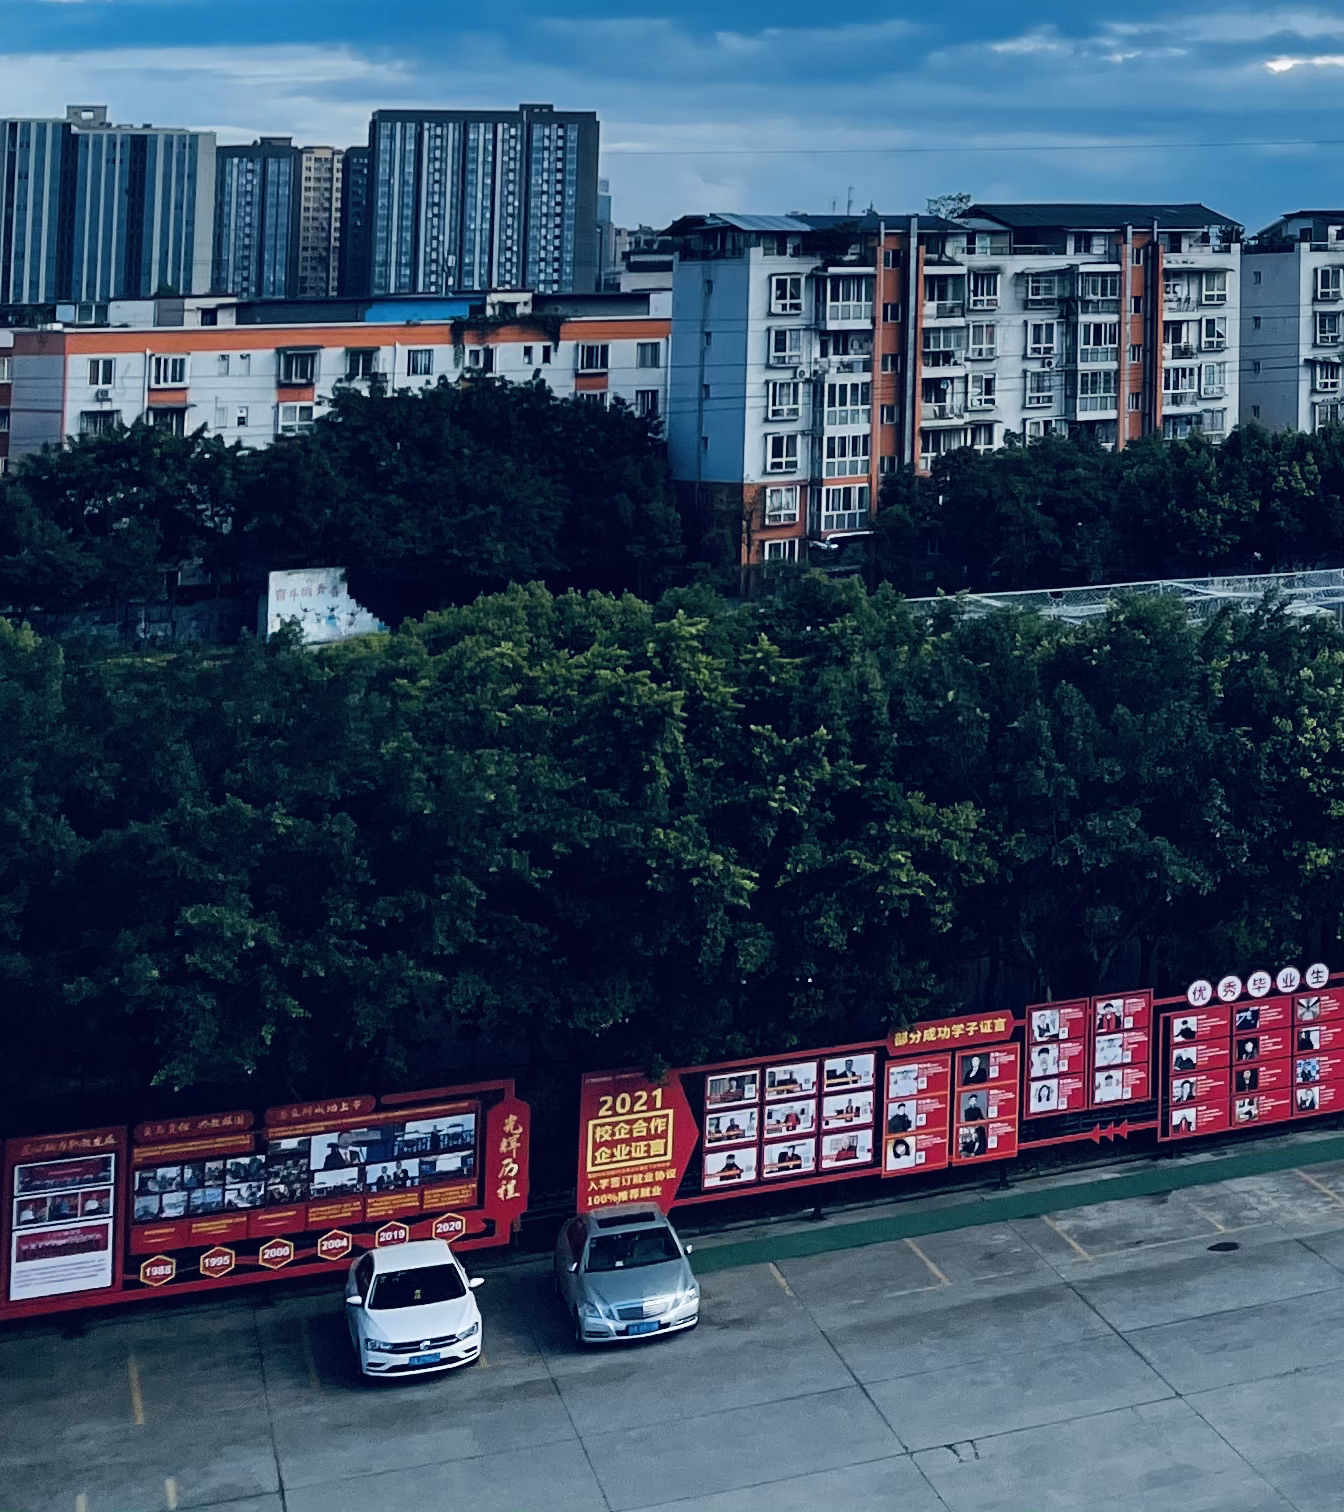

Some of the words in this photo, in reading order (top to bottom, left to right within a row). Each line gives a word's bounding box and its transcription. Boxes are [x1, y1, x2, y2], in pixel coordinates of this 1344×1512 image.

[1192, 969, 1325, 1001] 优秀毕业生
[894, 1017, 1008, 1047] 部分成功学子证言
[598, 1087, 663, 1117] 2021
[595, 1117, 668, 1143] 校企合作
[497, 1114, 523, 1201] 光辉历程
[595, 1139, 667, 1164] 企业证言
[321, 1238, 348, 1251] 2004
[379, 1229, 406, 1242] 2019
